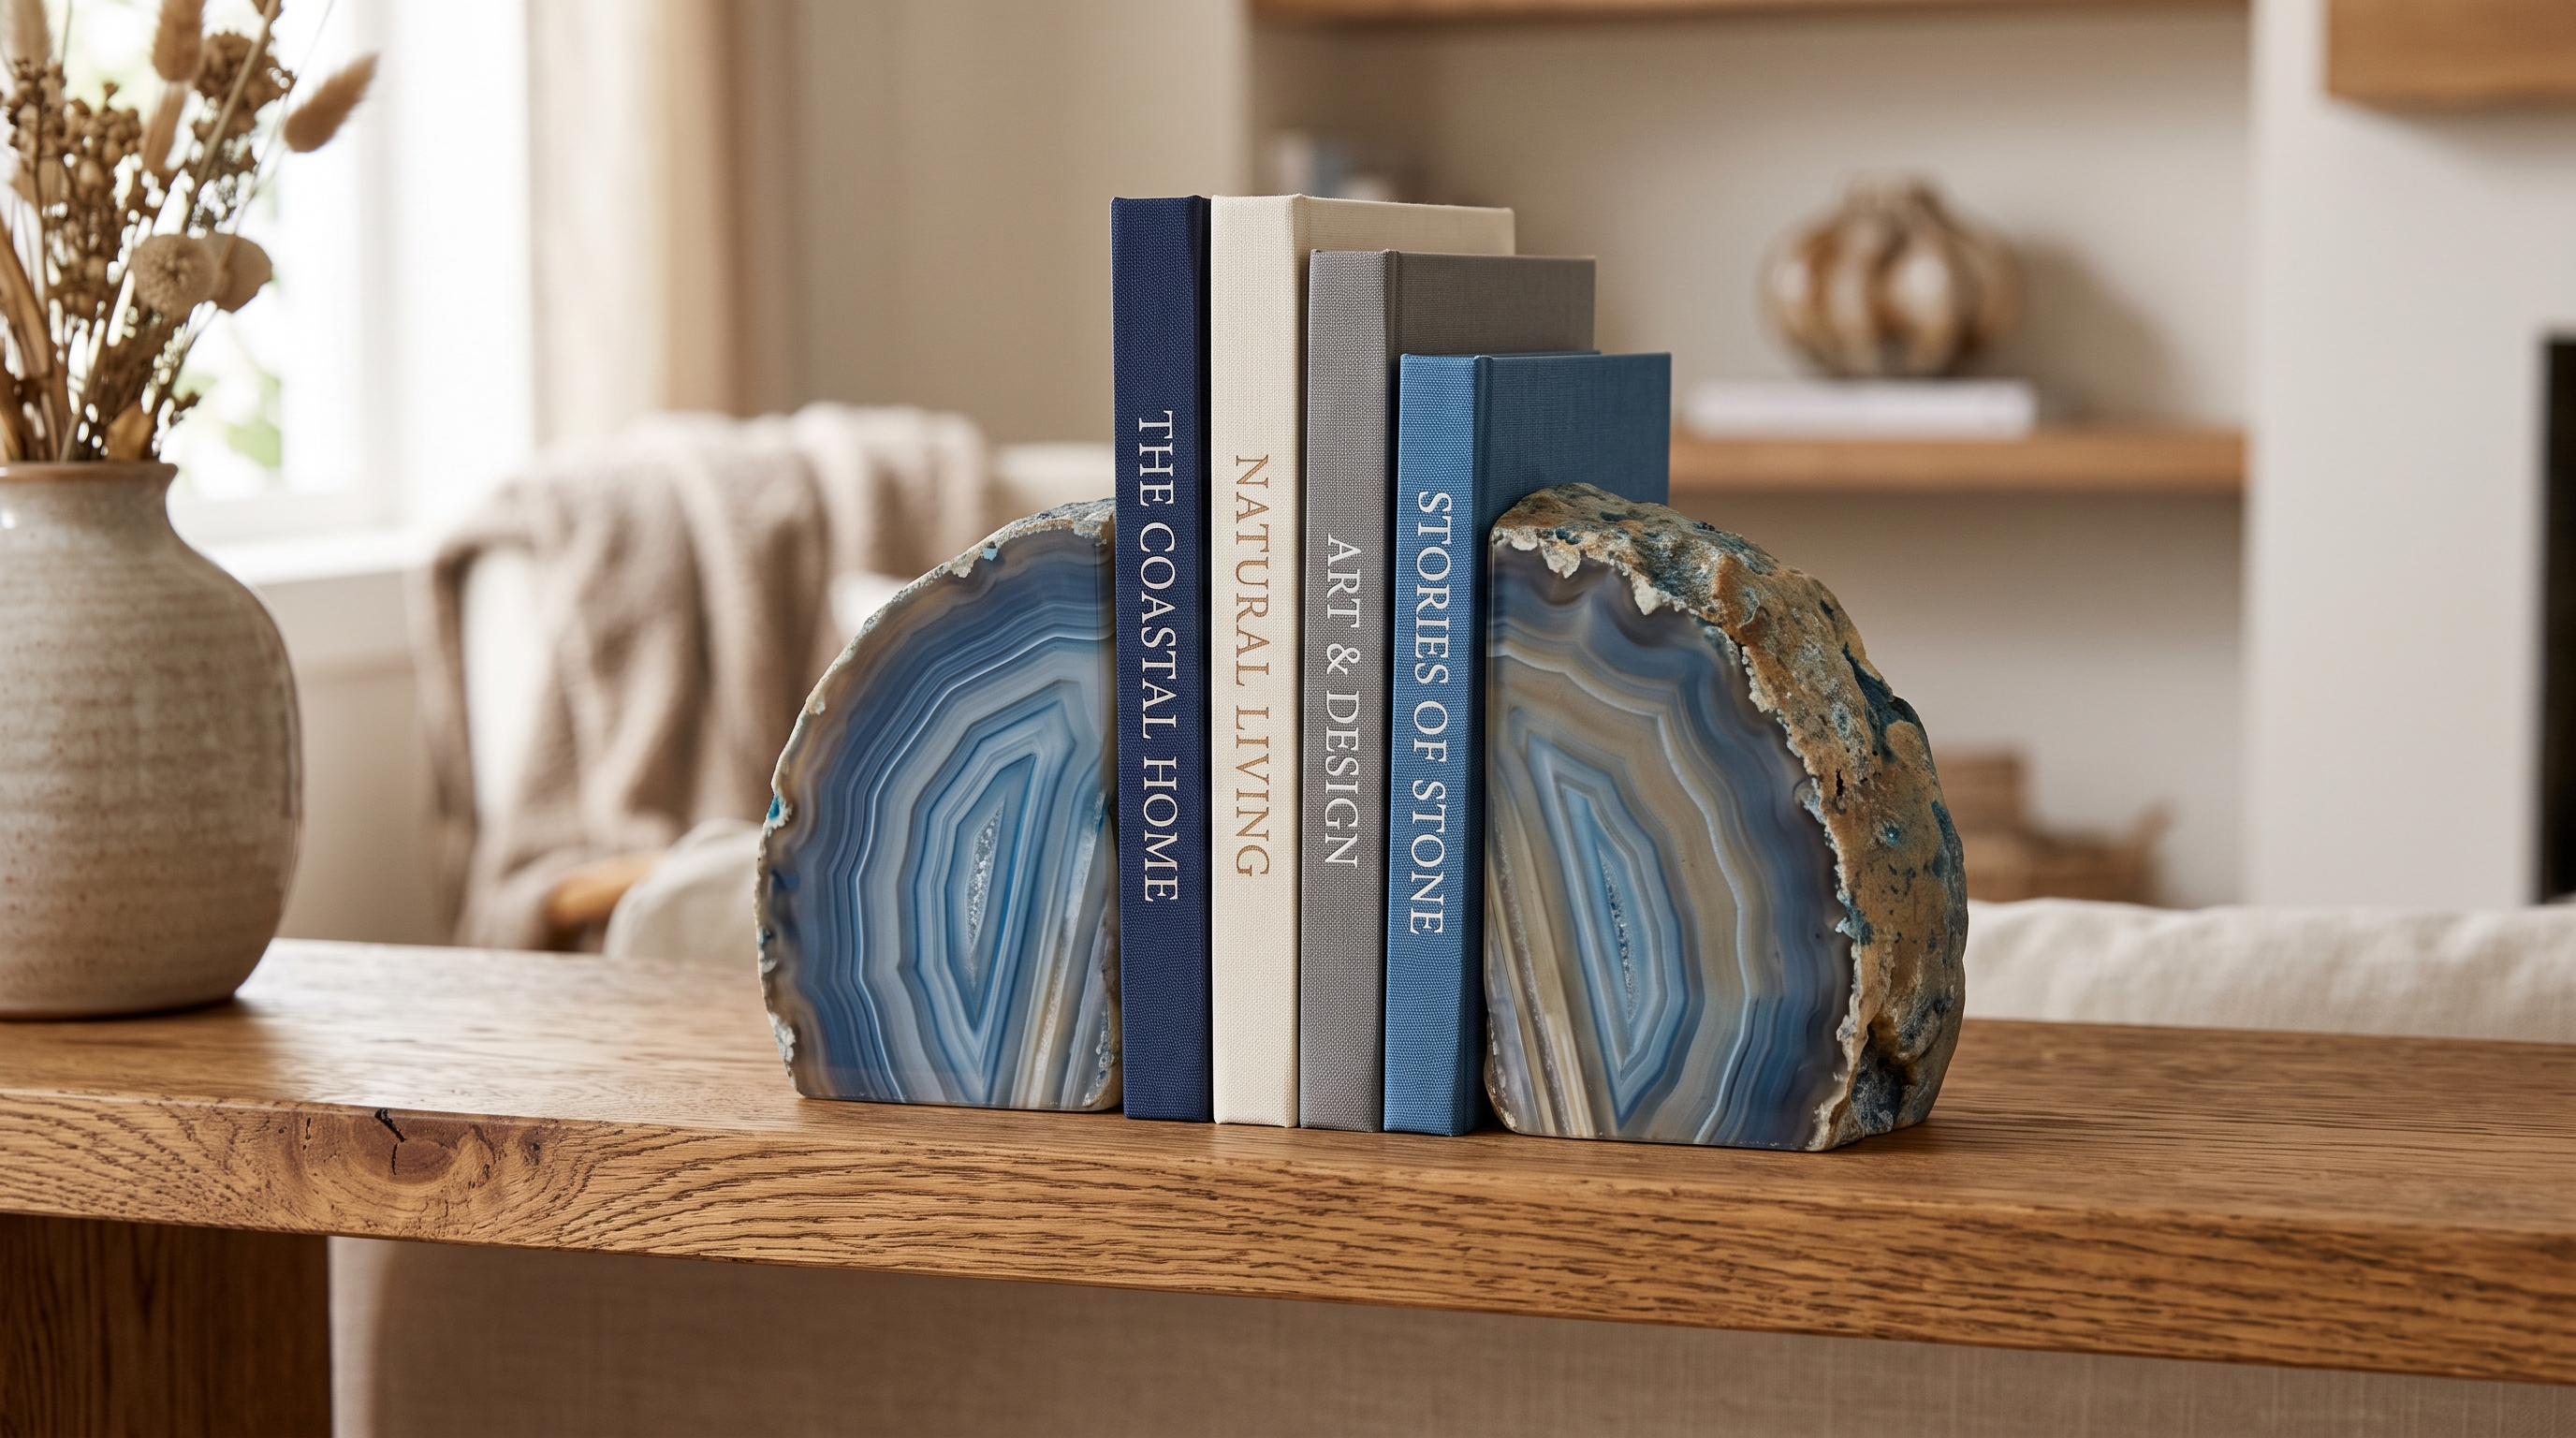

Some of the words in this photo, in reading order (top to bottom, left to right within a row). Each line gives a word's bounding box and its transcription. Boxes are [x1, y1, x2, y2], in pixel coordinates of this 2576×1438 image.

[1138, 410, 1174, 506] THE
[1139, 522, 1177, 740] COASTAL
[1236, 454, 1270, 687] NATURAL
[1326, 533, 1361, 626] ART
[1413, 491, 1452, 685] STORIES
[1326, 643, 1359, 676] &
[1412, 700, 1448, 763] OF
[1143, 756, 1178, 902] HOME
[1236, 705, 1271, 877] LIVING
[1324, 690, 1359, 869] DESIGN
[1409, 780, 1447, 936] STONE
